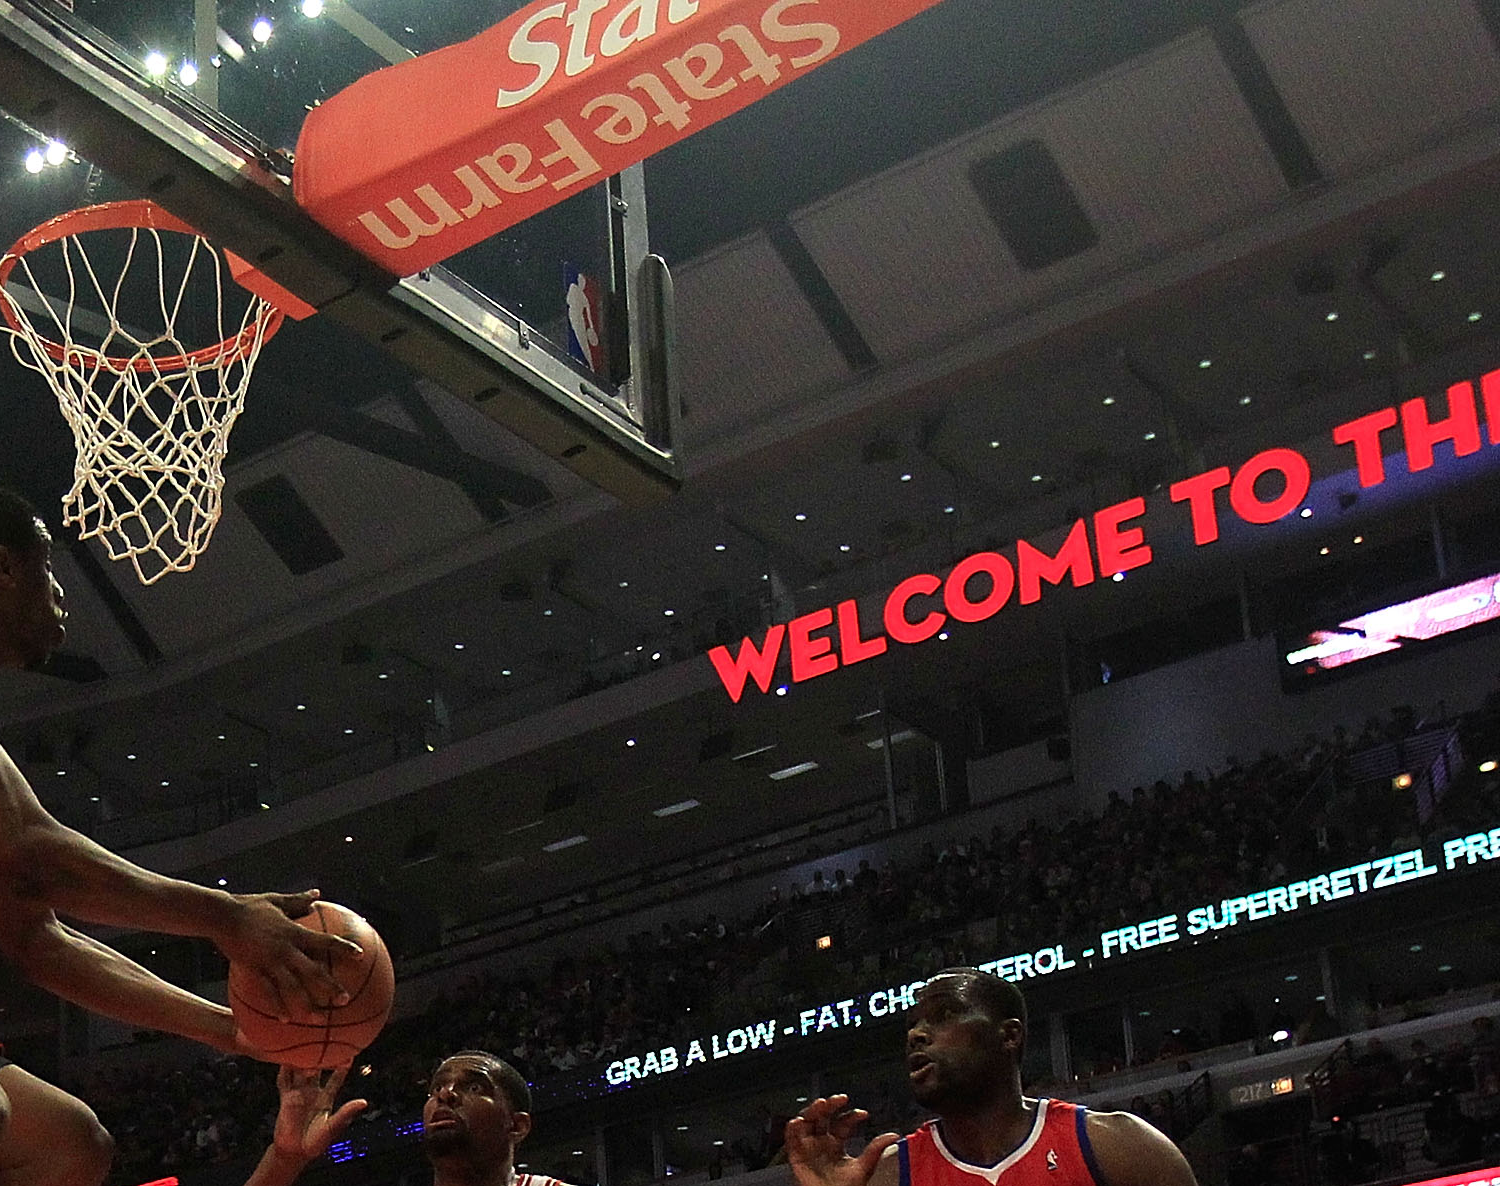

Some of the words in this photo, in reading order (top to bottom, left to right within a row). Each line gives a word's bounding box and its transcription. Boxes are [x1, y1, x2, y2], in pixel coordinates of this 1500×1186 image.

[580, 0, 841, 145] State
[357, 118, 602, 250] Farm
[708, 497, 1152, 703] WELCOME
[1170, 447, 1312, 546] TO
[604, 1046, 679, 1086] GRAB
[686, 1039, 706, 1066] A
[712, 1019, 776, 1060] LOW
[799, 999, 862, 1036] FAT,
[1101, 914, 1181, 959] FREE
[1186, 848, 1438, 936] SUPERPRETZEL
